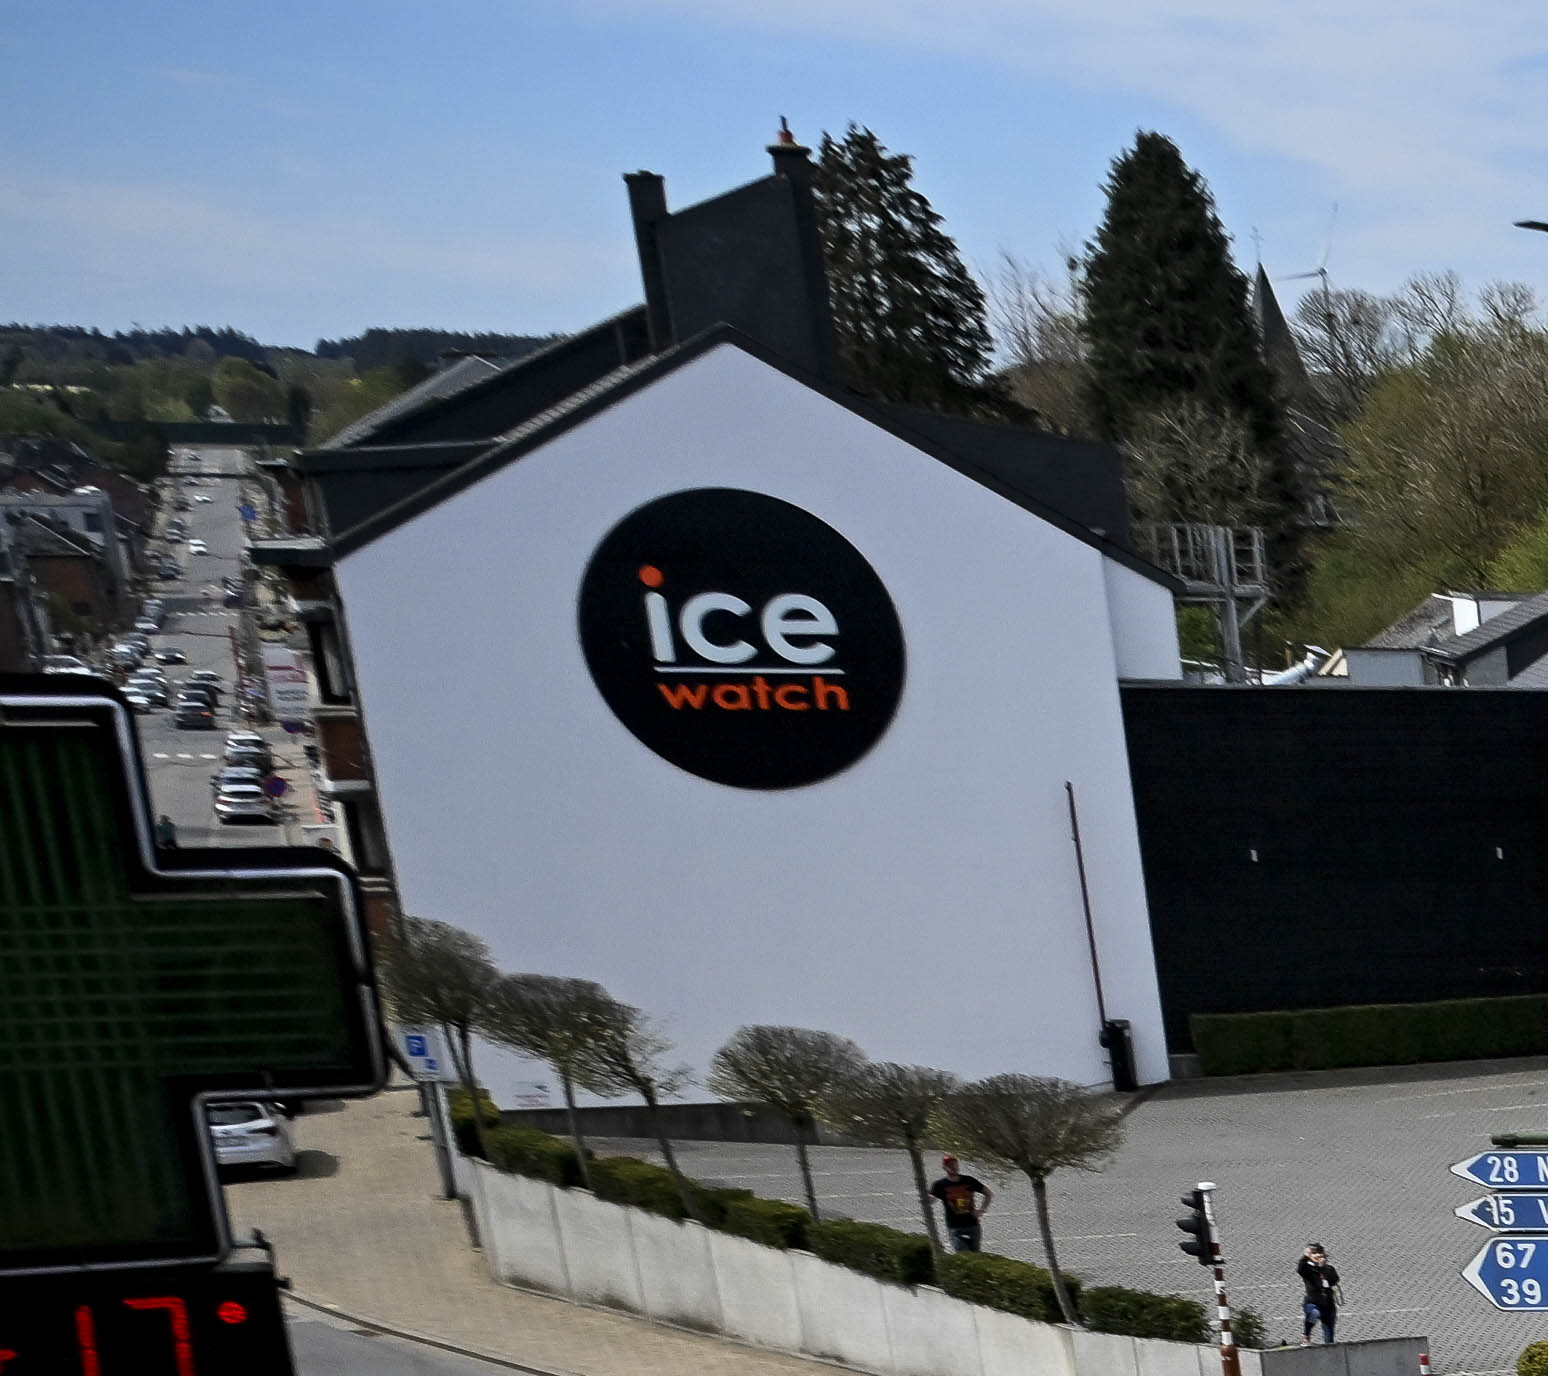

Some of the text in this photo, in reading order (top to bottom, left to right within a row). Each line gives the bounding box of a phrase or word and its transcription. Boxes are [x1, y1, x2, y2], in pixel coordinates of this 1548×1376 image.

[638, 564, 840, 665] ice
[656, 676, 850, 711] watch
[1487, 1156, 1519, 1182] 28
[1490, 1200, 1515, 1226] 15
[1495, 1243, 1536, 1269] 67
[1500, 1279, 1542, 1305] 39
